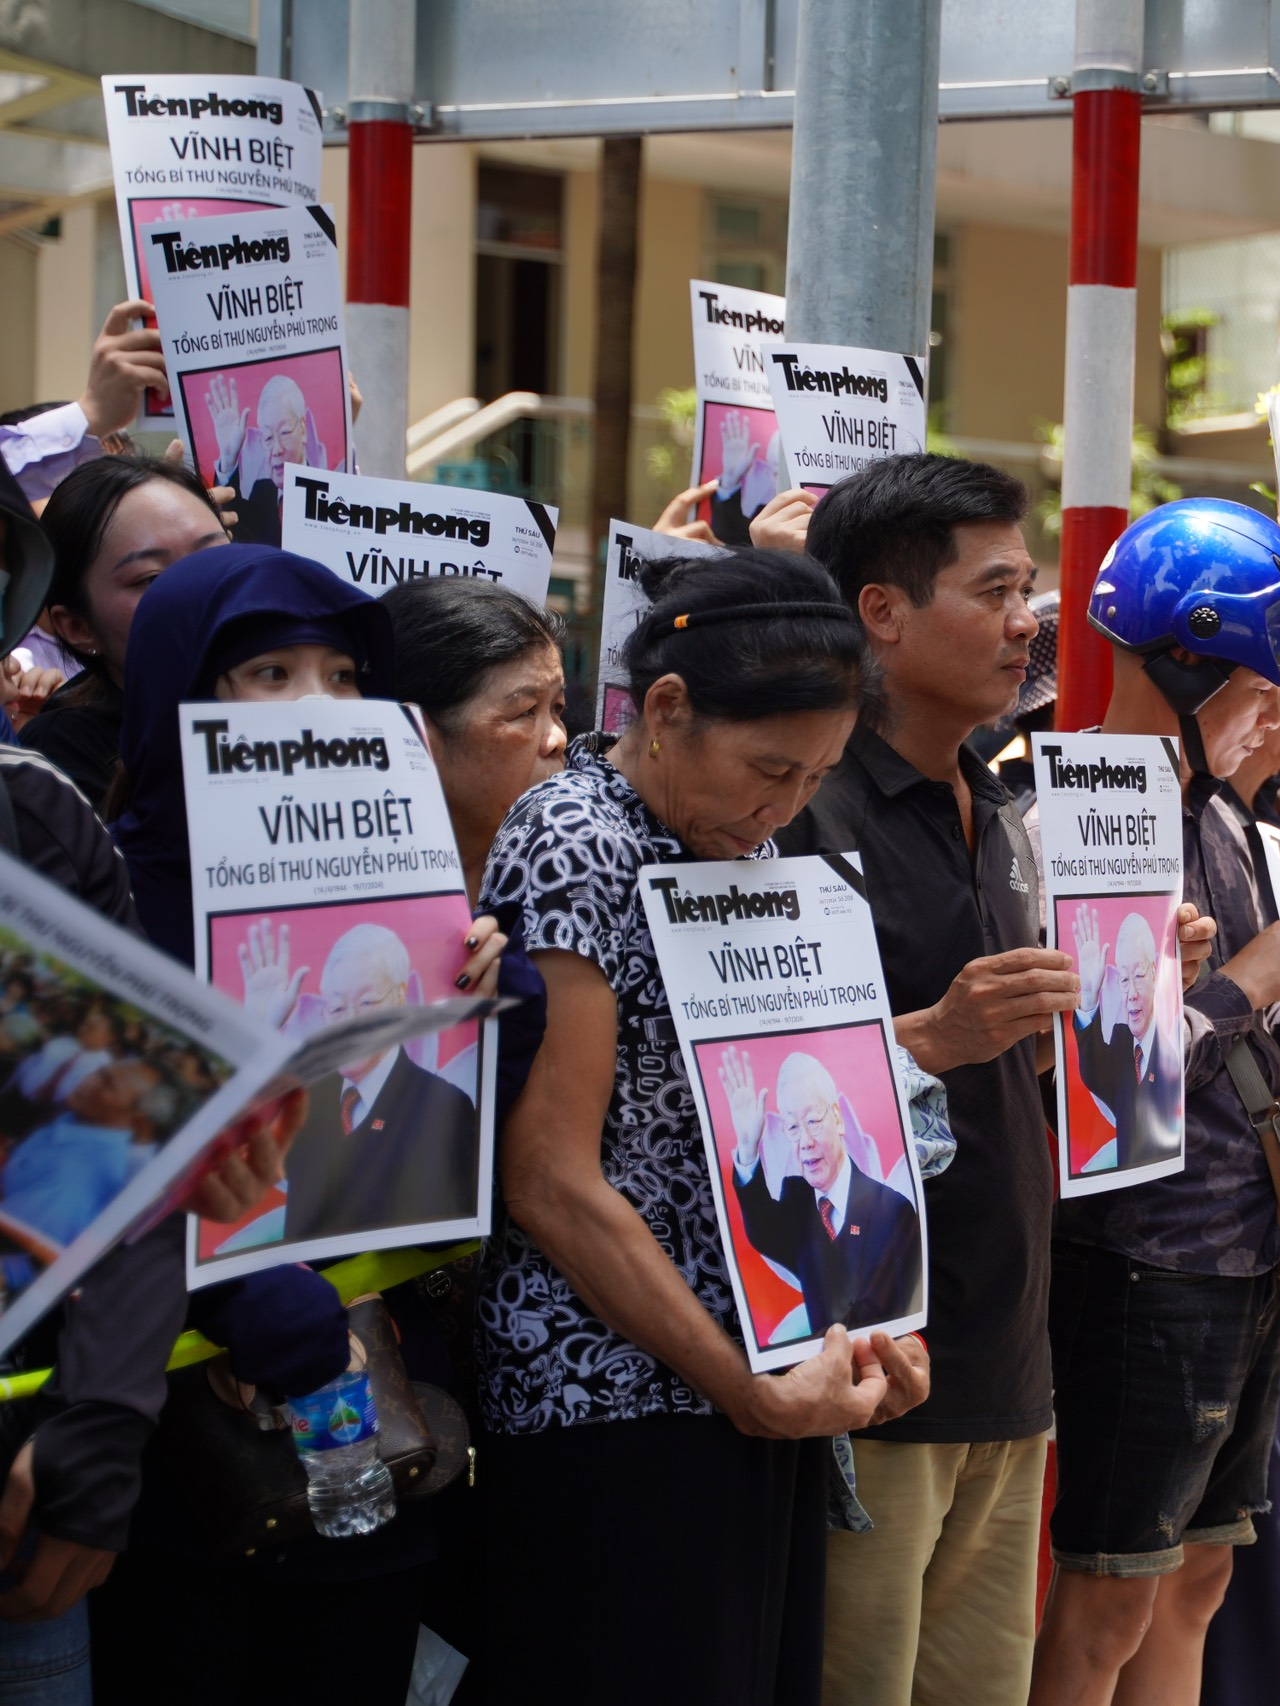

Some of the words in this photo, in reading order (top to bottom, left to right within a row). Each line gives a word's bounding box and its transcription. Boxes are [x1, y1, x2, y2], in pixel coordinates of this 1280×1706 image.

[170, 131, 242, 161] VĨNH
[249, 136, 294, 172] BIỆT
[170, 166, 183, 182] BÍ
[186, 169, 215, 184] THƯ
[218, 168, 271, 189] NGUYỄN
[272, 174, 292, 194] PHÚ
[294, 182, 316, 201] TRỌNG
[207, 284, 262, 321] VĨNH
[267, 275, 303, 316] BIỆT
[172, 331, 209, 355] TỔNG
[211, 334, 223, 350] BÍ
[224, 332, 245, 347] THƯ
[247, 319, 286, 345] NGUYỄN
[287, 319, 306, 338] PHÚ
[307, 316, 338, 337] TRỌNG
[733, 344, 764, 374] VĨN
[822, 409, 864, 447] VĨNH
[868, 415, 897, 455] BIỆT
[794, 446, 824, 468] TỔNG
[825, 450, 834, 469] BÍ
[835, 454, 850, 471] THƯ
[258, 795, 345, 845] VĨNH
[352, 789, 414, 844] BIỆT
[1077, 808, 1123, 846] VĨNH
[1126, 808, 1157, 851] BIỆT
[205, 856, 254, 889] TỔNG
[259, 857, 275, 884] BÍ
[278, 856, 314, 882] THƯ
[316, 846, 384, 879] NGUYỄN
[387, 845, 418, 873] PHÚ
[420, 849, 458, 871] TRỌNG
[1051, 852, 1077, 877] TỔNG
[1079, 856, 1088, 876] BÍ
[1088, 856, 1107, 875] THƯ
[1107, 852, 1142, 875] NGUYỄN
[1143, 853, 1157, 874] PHÚ
[1158, 857, 1180, 877] TRỌNG
[708, 941, 773, 984] VĨNH
[773, 935, 823, 983] BIỆT
[681, 993, 718, 1020] TỔNG
[719, 994, 733, 1017] BÍ
[732, 993, 758, 1015] THƯ
[759, 985, 802, 1013] NGUYỄN
[803, 985, 828, 1008] PHÚ
[829, 982, 877, 1007] TRỌNG
